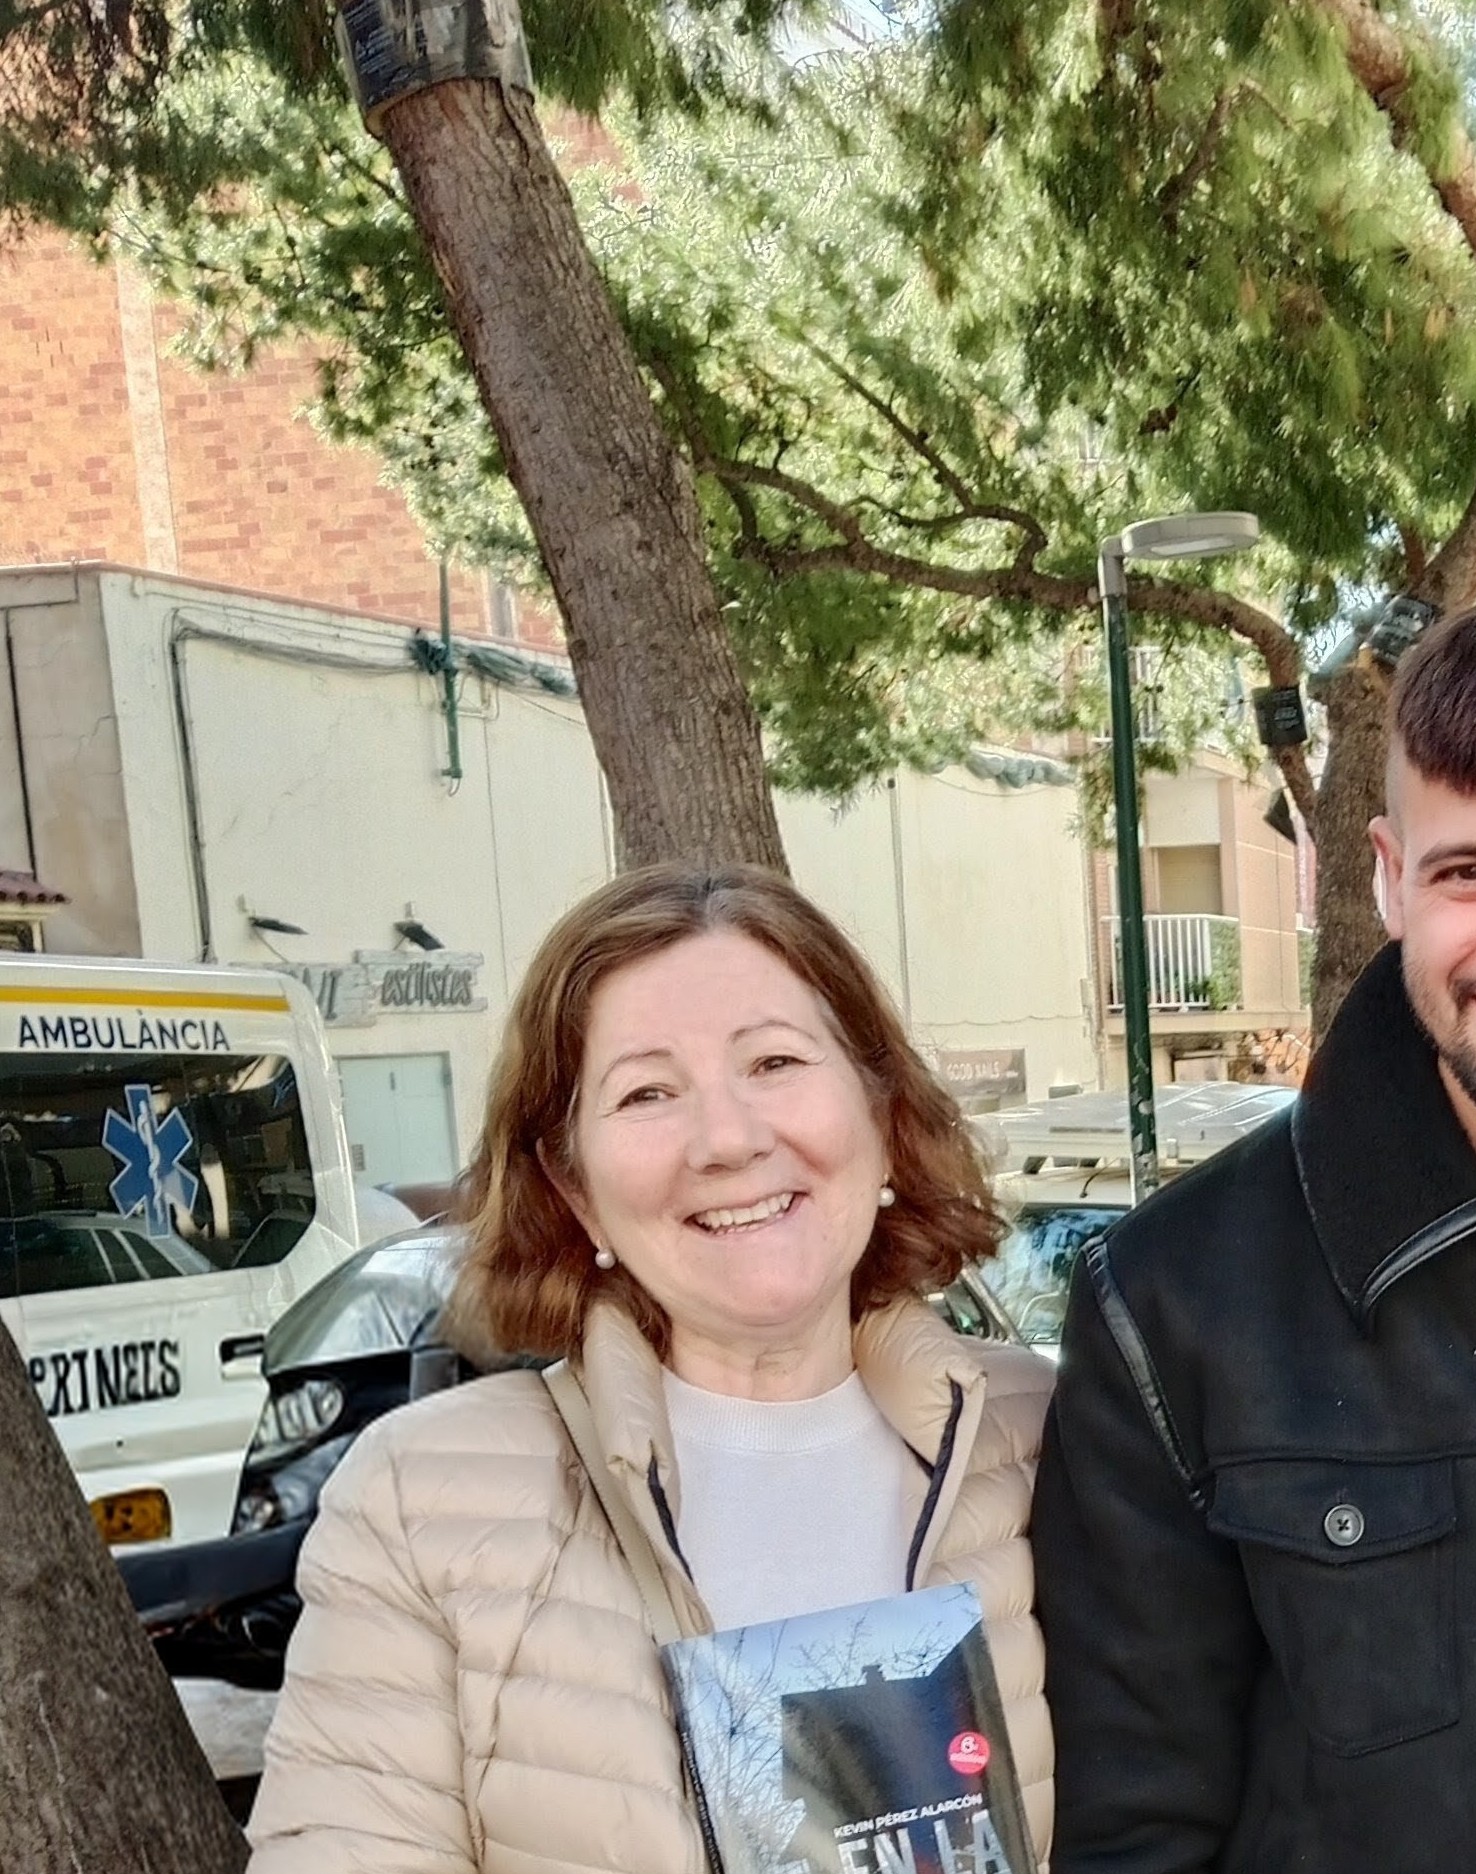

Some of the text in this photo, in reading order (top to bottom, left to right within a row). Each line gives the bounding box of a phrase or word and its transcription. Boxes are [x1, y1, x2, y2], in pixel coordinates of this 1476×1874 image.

[19, 1009, 230, 1050] AMBULÀNCIA
[834, 1793, 983, 1838] KEVIN PÉREZ ALARCÓN
